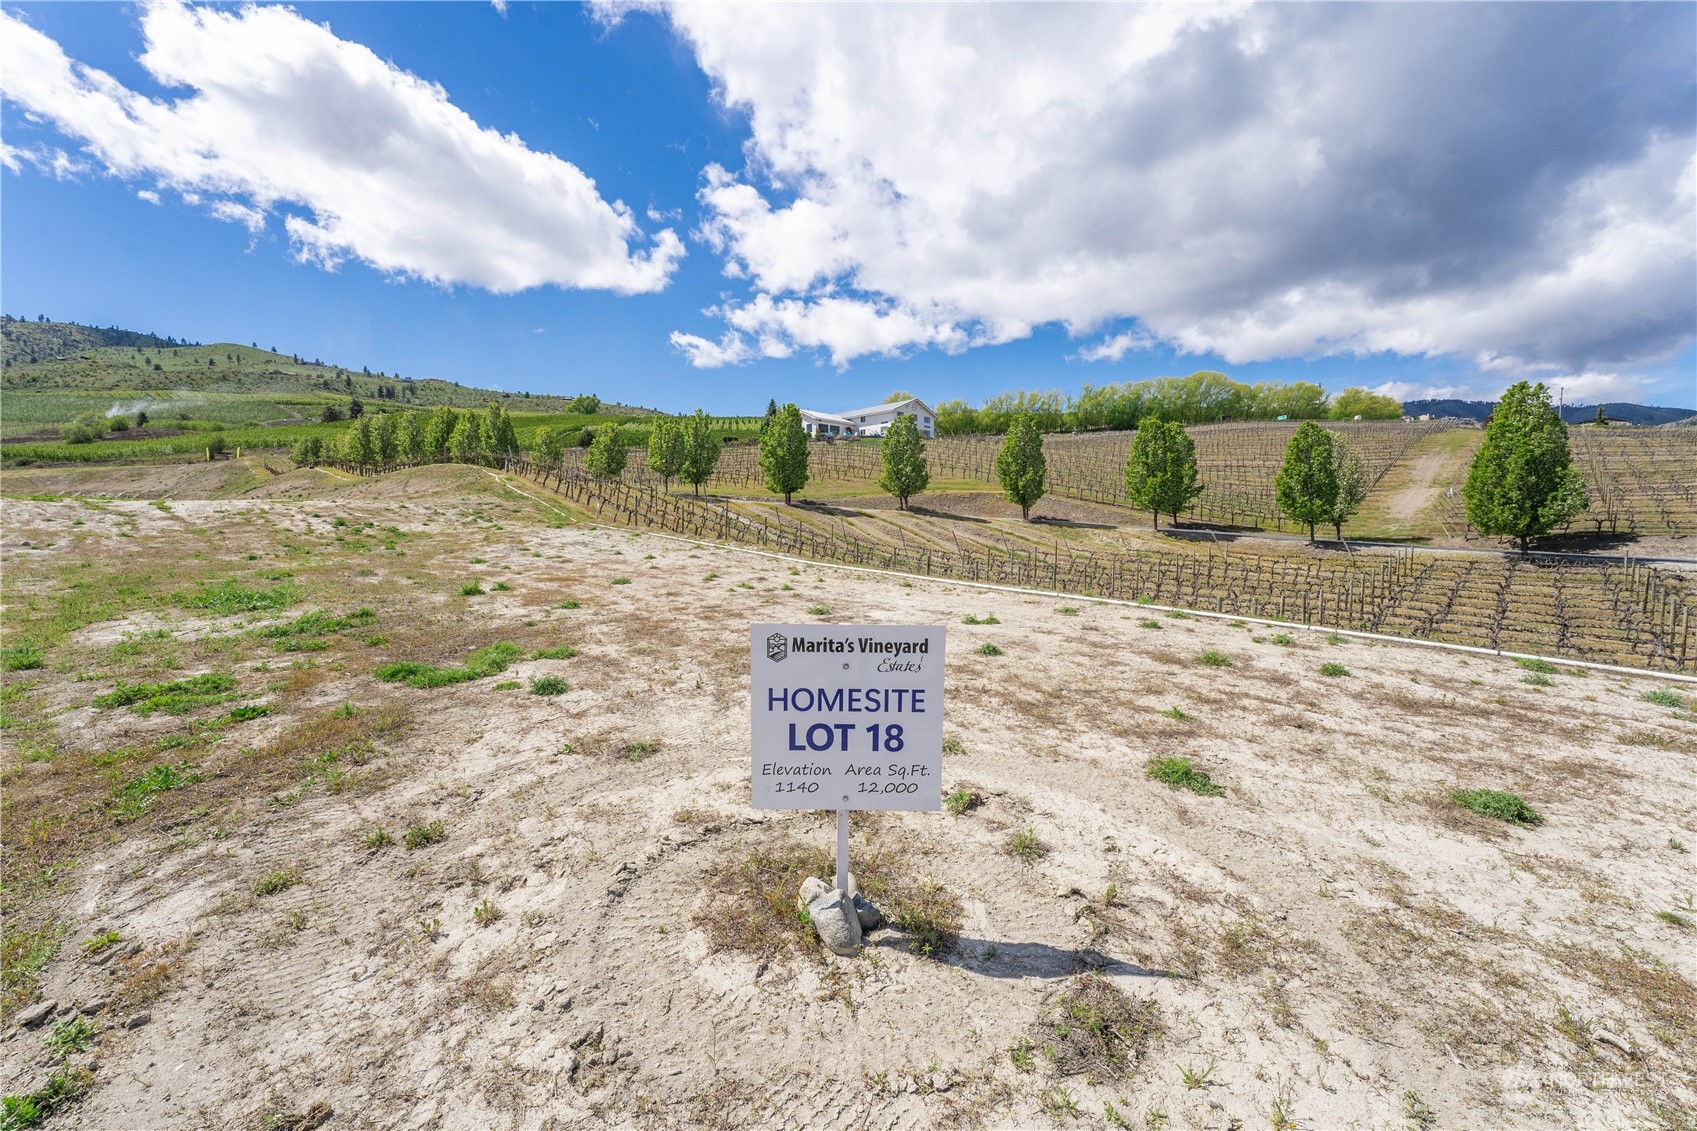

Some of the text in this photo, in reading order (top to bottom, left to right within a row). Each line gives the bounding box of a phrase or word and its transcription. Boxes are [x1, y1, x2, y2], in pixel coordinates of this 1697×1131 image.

[792, 637, 928, 658] Marita's Vineyard
[768, 687, 926, 713] HOMESITE
[788, 723, 904, 752] LOT 18
[762, 762, 930, 780] Elevation Area Sq.Ft.
[775, 782, 918, 795] 1140 12,000
